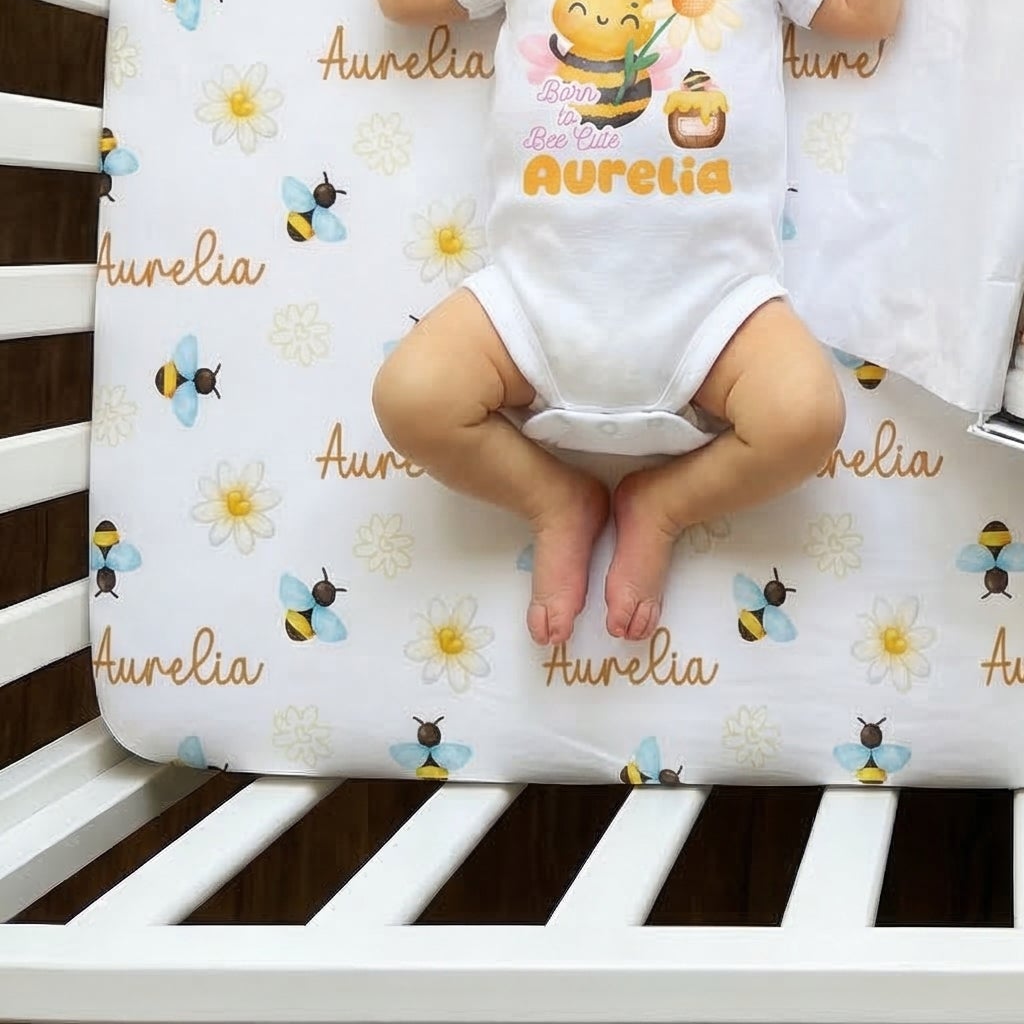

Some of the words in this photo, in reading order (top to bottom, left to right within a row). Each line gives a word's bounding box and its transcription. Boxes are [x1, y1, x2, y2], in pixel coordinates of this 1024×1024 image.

[317, 24, 495, 81] Aurelia
[536, 78, 599, 104] Born
[557, 104, 578, 127] to
[522, 125, 569, 152] Bee
[573, 125, 621, 152] Cute
[523, 153, 733, 196] Aurelia
[97, 228, 266, 288] Aurelia
[817, 419, 944, 479] relia
[93, 625, 265, 687] Aurelia
[542, 626, 719, 687] Aurelia
